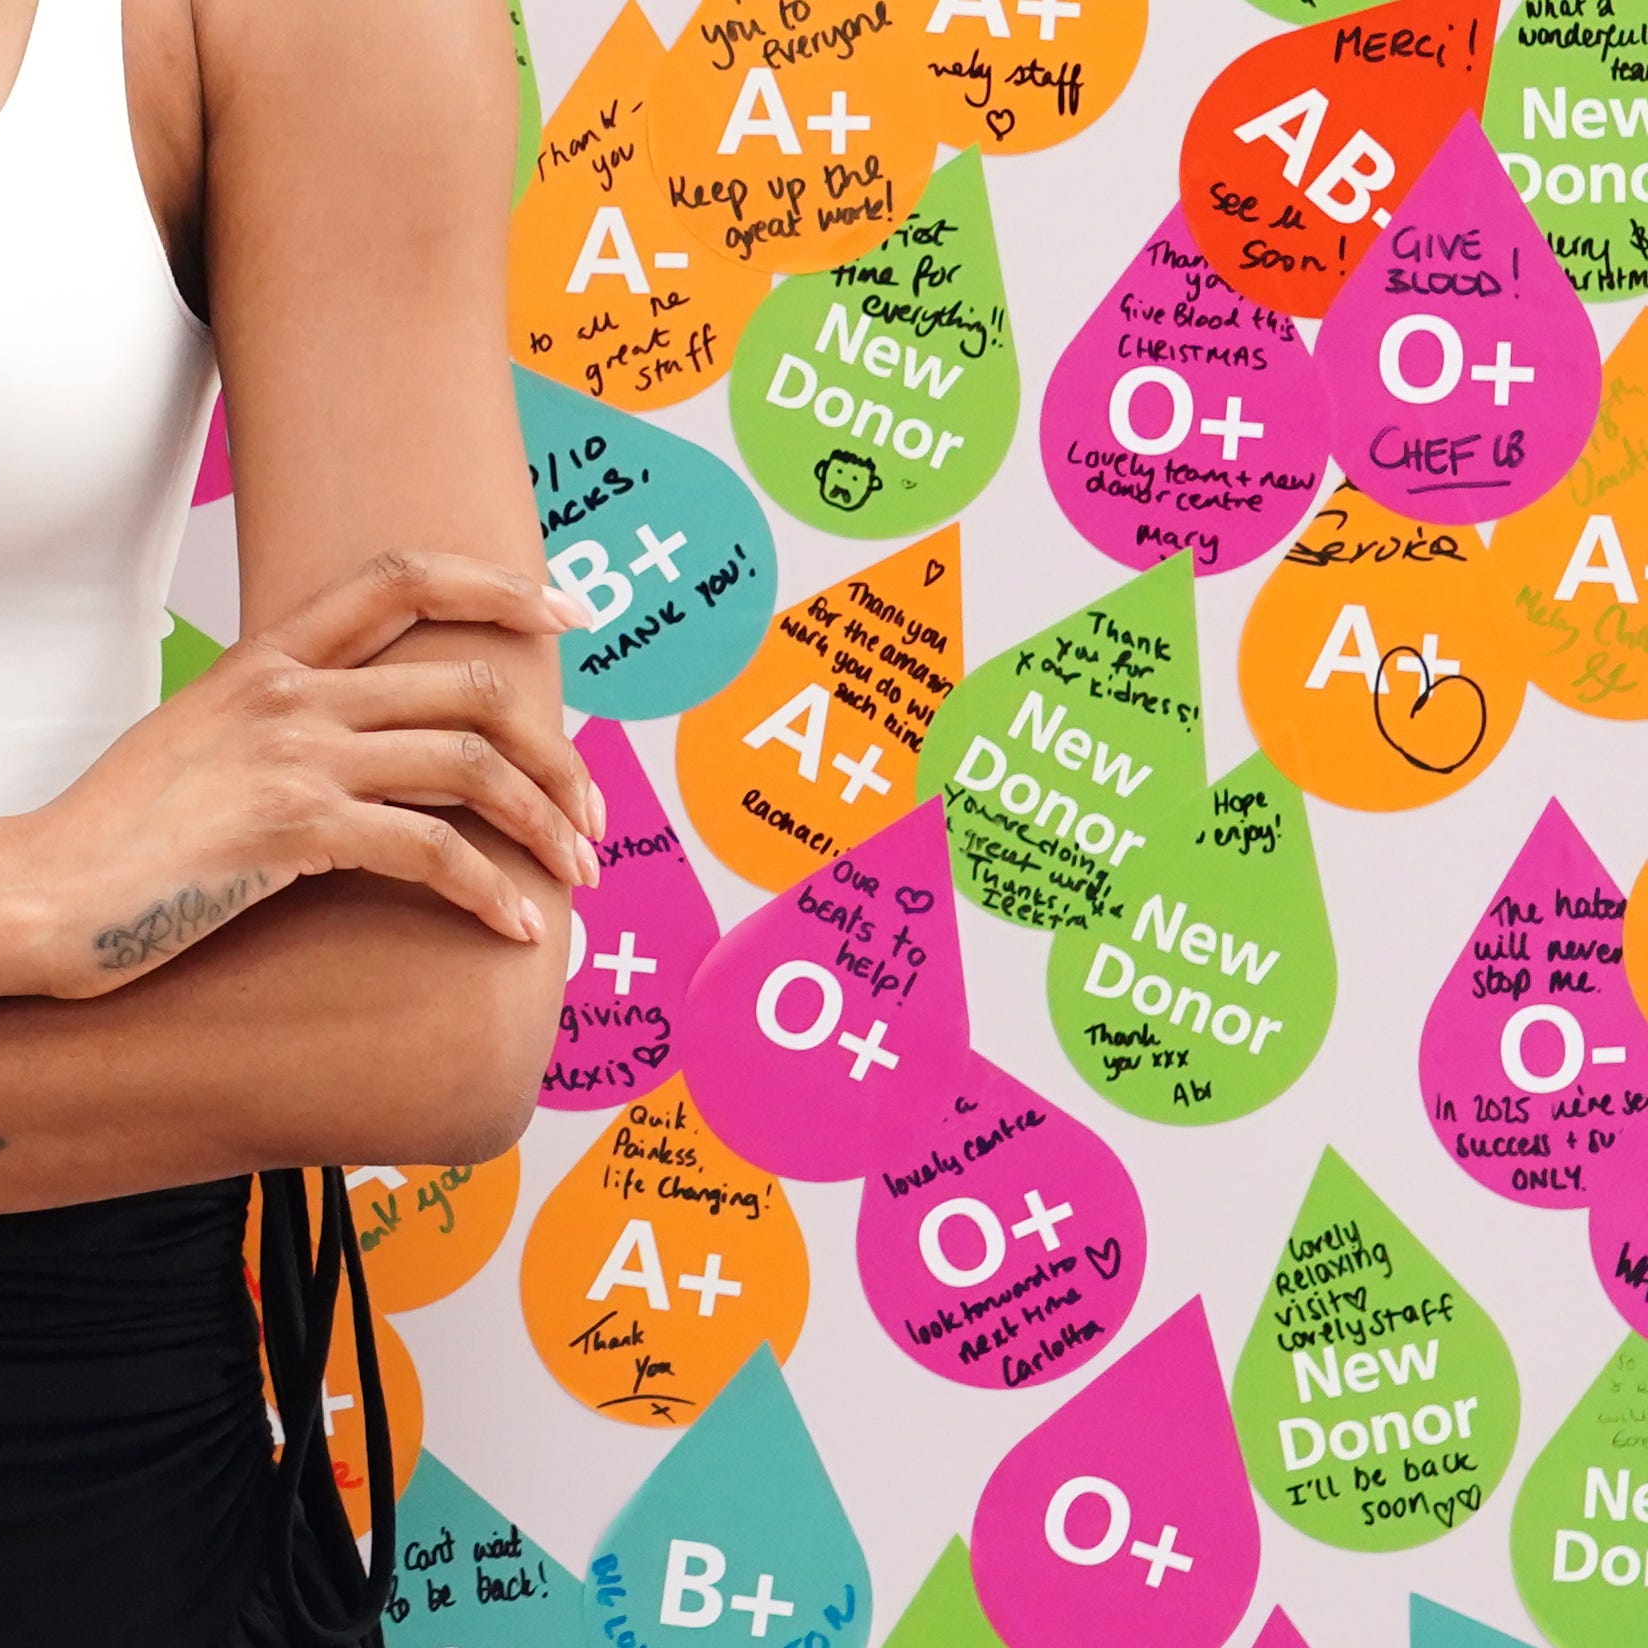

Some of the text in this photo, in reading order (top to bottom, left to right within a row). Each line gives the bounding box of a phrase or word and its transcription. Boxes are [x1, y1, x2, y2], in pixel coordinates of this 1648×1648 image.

[716, 65, 872, 158] A+
[766, 155, 886, 214] up the
[1391, 228, 1483, 260] GIVE
[1117, 336, 1269, 371] CHRISTMAS
[1377, 314, 1536, 407] O+
[764, 353, 965, 473] Donor
[1370, 428, 1478, 473] CHEF
[578, 545, 757, 677] THANK YOU!
[1476, 1094, 1531, 1124] 2025
[585, 1219, 743, 1319] A+
[917, 1188, 1075, 1290] O+
[1291, 1340, 1441, 1404] New
[1277, 1394, 1481, 1472] Donor
[1043, 1475, 1194, 1589] O+
